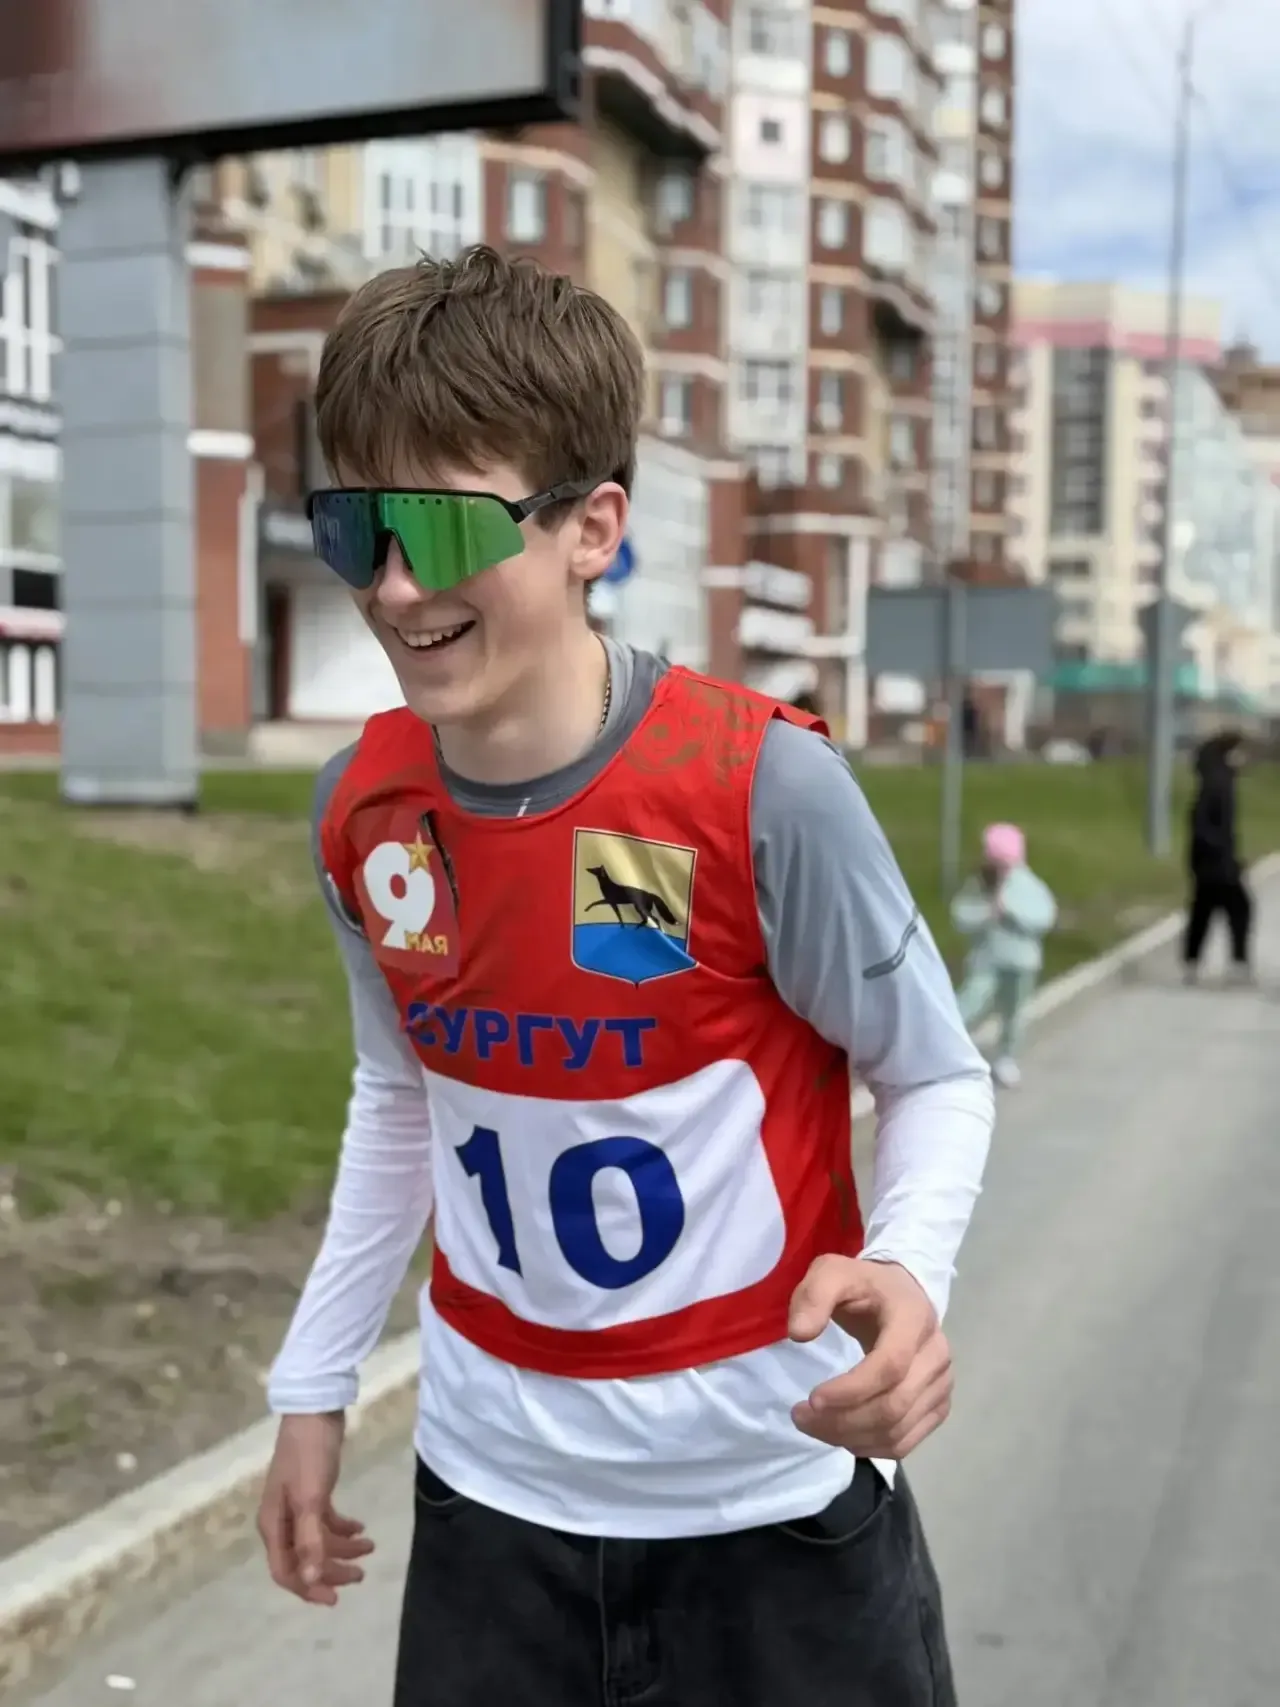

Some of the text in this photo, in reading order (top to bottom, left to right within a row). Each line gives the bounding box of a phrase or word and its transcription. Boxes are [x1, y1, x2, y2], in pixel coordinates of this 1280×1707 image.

[363, 841, 435, 949] 9
[404, 930, 449, 956] МАЯ
[454, 1124, 685, 1290] 10
